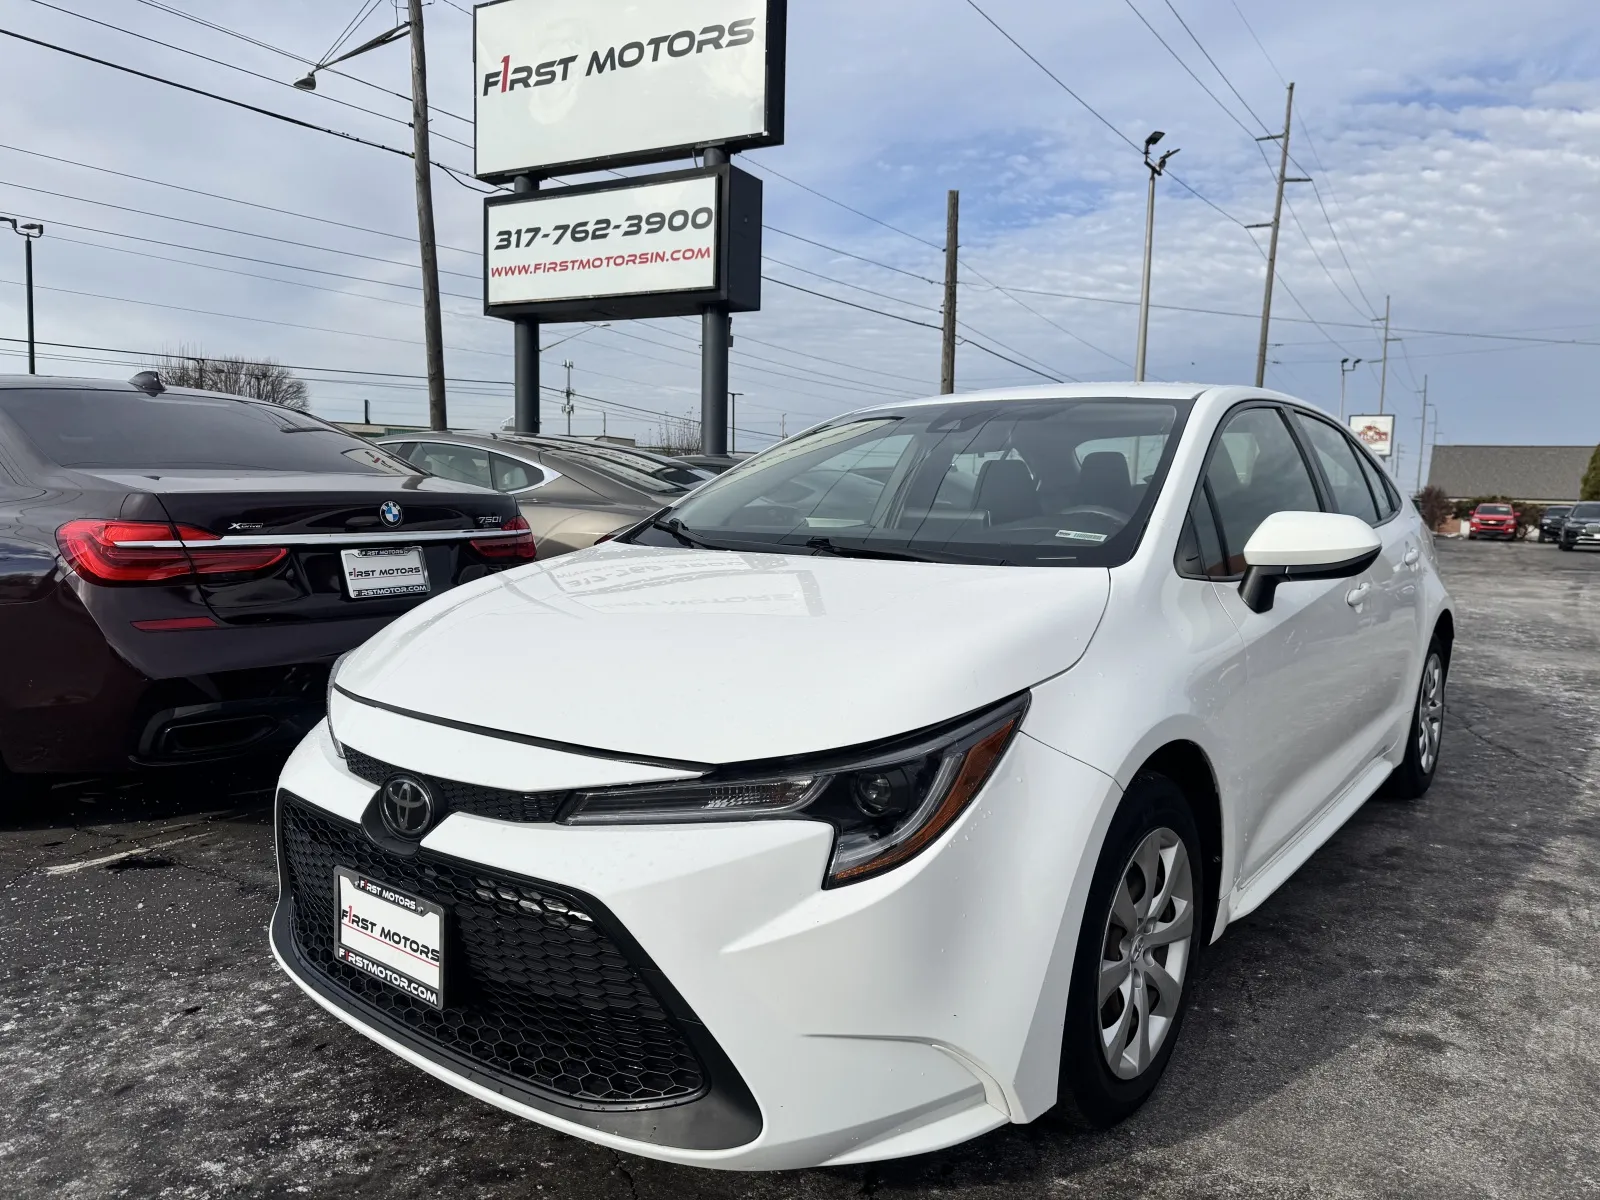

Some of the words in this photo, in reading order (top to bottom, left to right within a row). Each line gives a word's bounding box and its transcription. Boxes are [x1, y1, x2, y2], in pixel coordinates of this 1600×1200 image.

[585, 17, 756, 77] MOTORS
[494, 206, 713, 250] 317-762-3900
[491, 247, 711, 278] WWW.FIRSTMOTORSIN.COM
[379, 566, 421, 576] MOTORS
[382, 889, 416, 910] MOTORS
[379, 926, 440, 963] MOTORS
